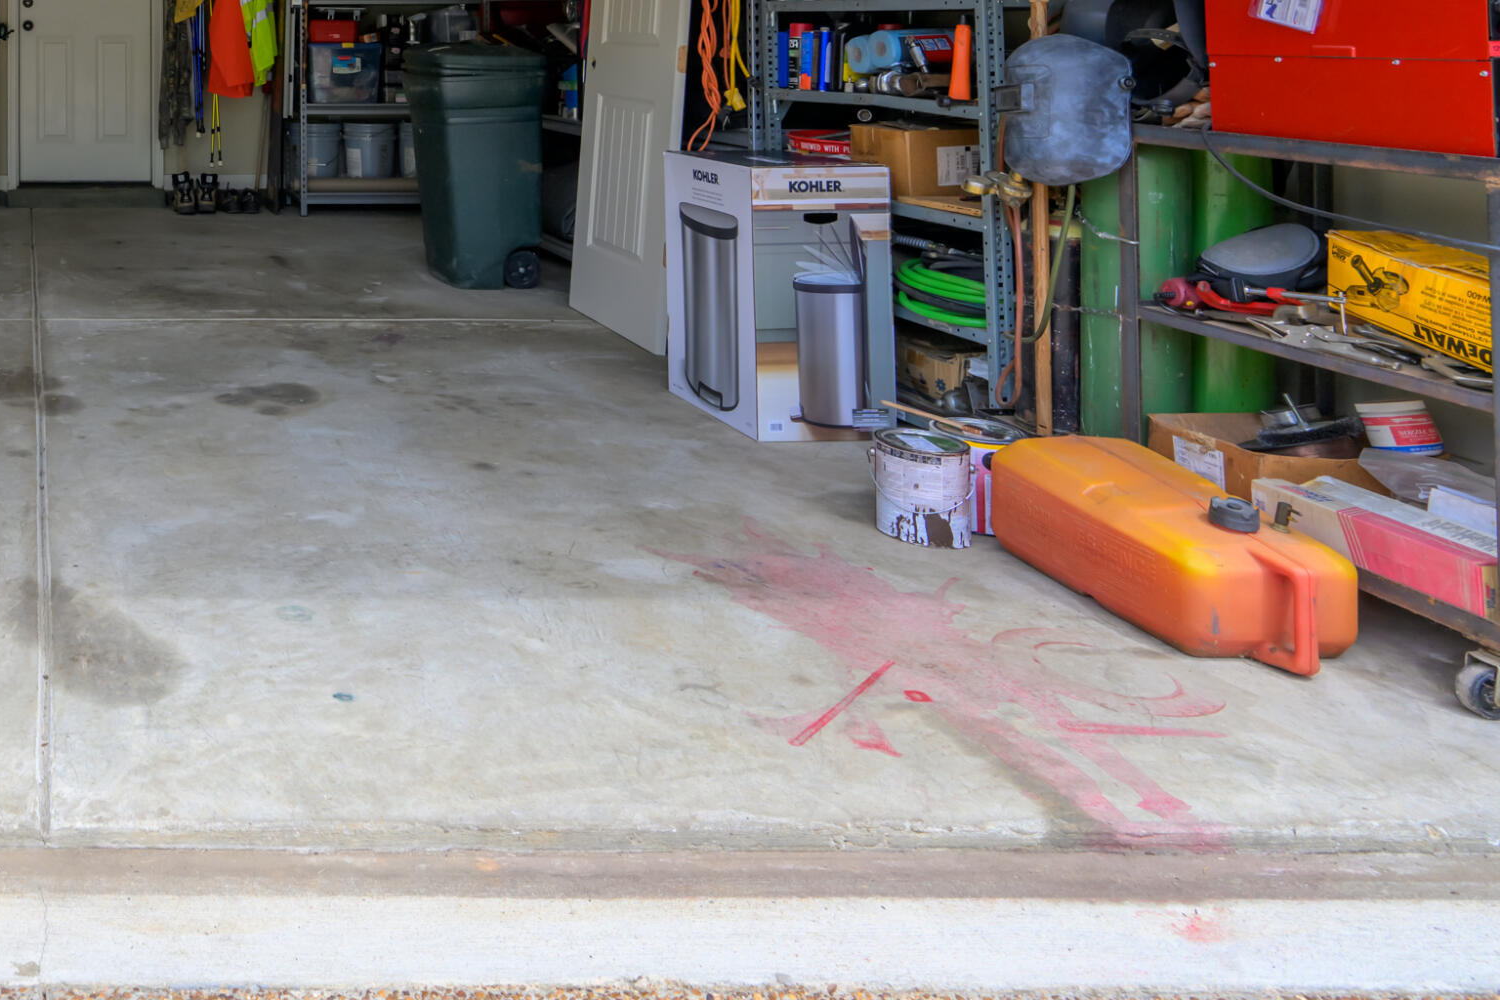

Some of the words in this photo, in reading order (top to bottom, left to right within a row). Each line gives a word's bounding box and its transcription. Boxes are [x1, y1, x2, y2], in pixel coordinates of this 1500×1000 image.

[823, 144, 840, 153] WITH
[692, 168, 720, 185] KOHLER
[788, 180, 842, 193] KOHLER
